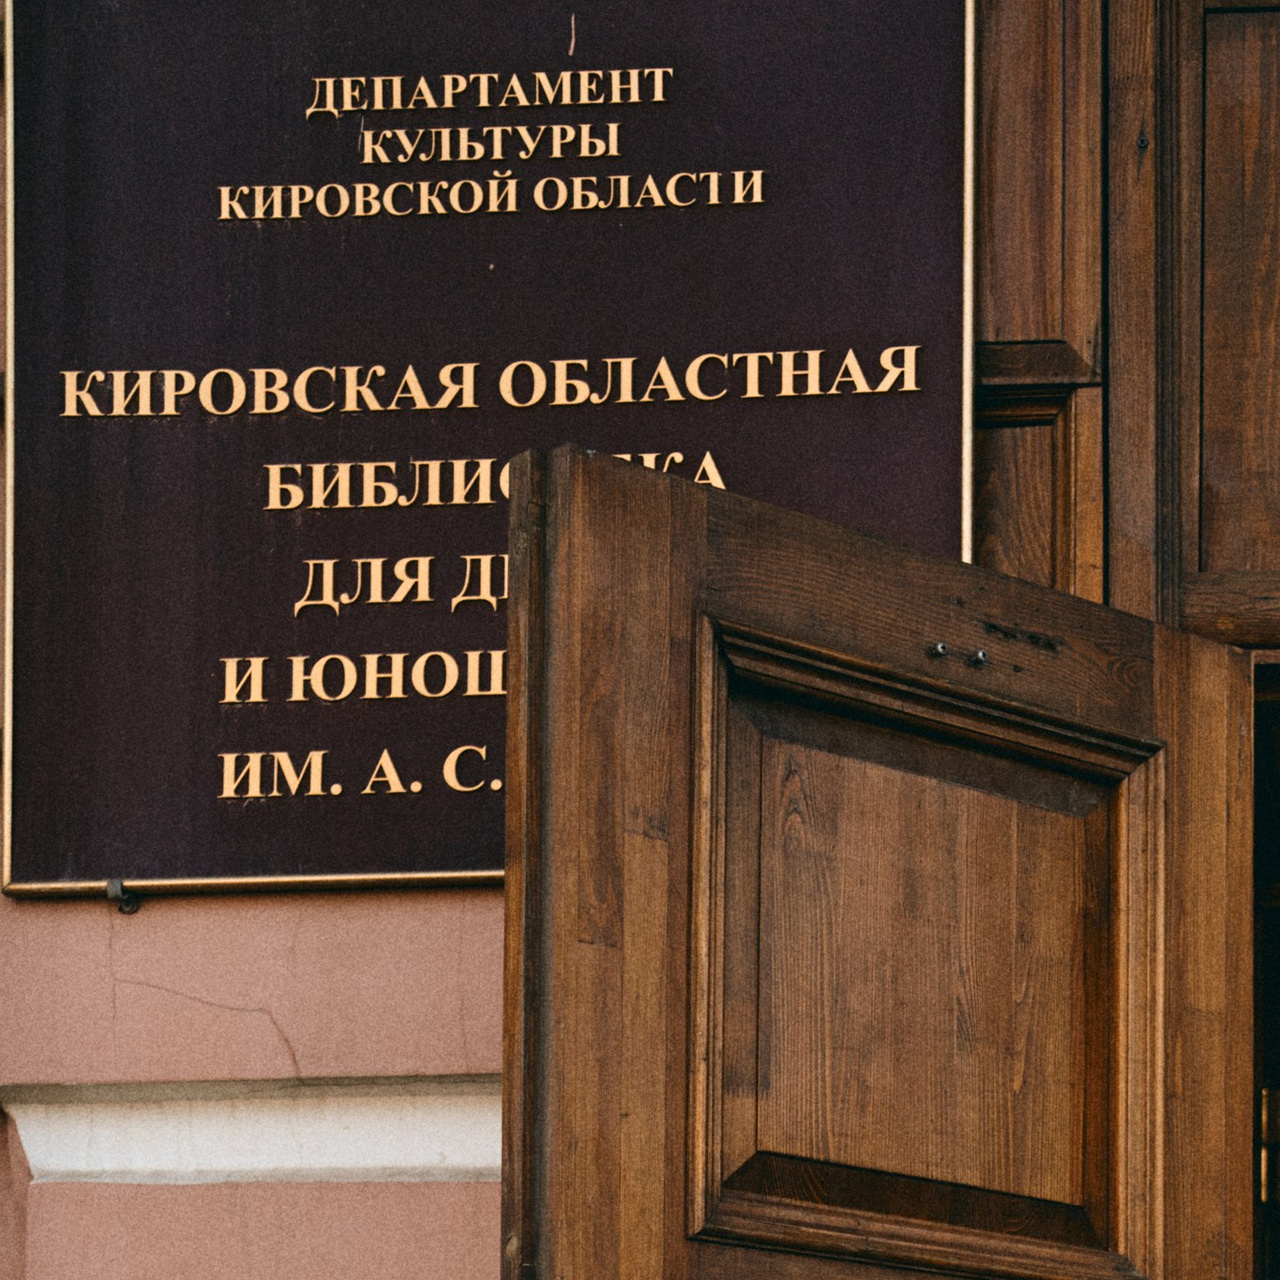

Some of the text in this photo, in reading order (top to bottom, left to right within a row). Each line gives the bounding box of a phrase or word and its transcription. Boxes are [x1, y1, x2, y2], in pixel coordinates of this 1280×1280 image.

[306, 67, 674, 119] ДЕПАРТАМЕНТ
[361, 122, 620, 165] КУЛЬТУРЫ
[218, 170, 765, 220] КИРОВСКОЙ ОБЛАСТИ
[60, 345, 921, 417] КИРОВСКАЯ ОБЛАСТНАЯ
[293, 556, 435, 617] ДЛЯ
[219, 656, 268, 703] И
[217, 745, 503, 799] ИМ. А. С.
